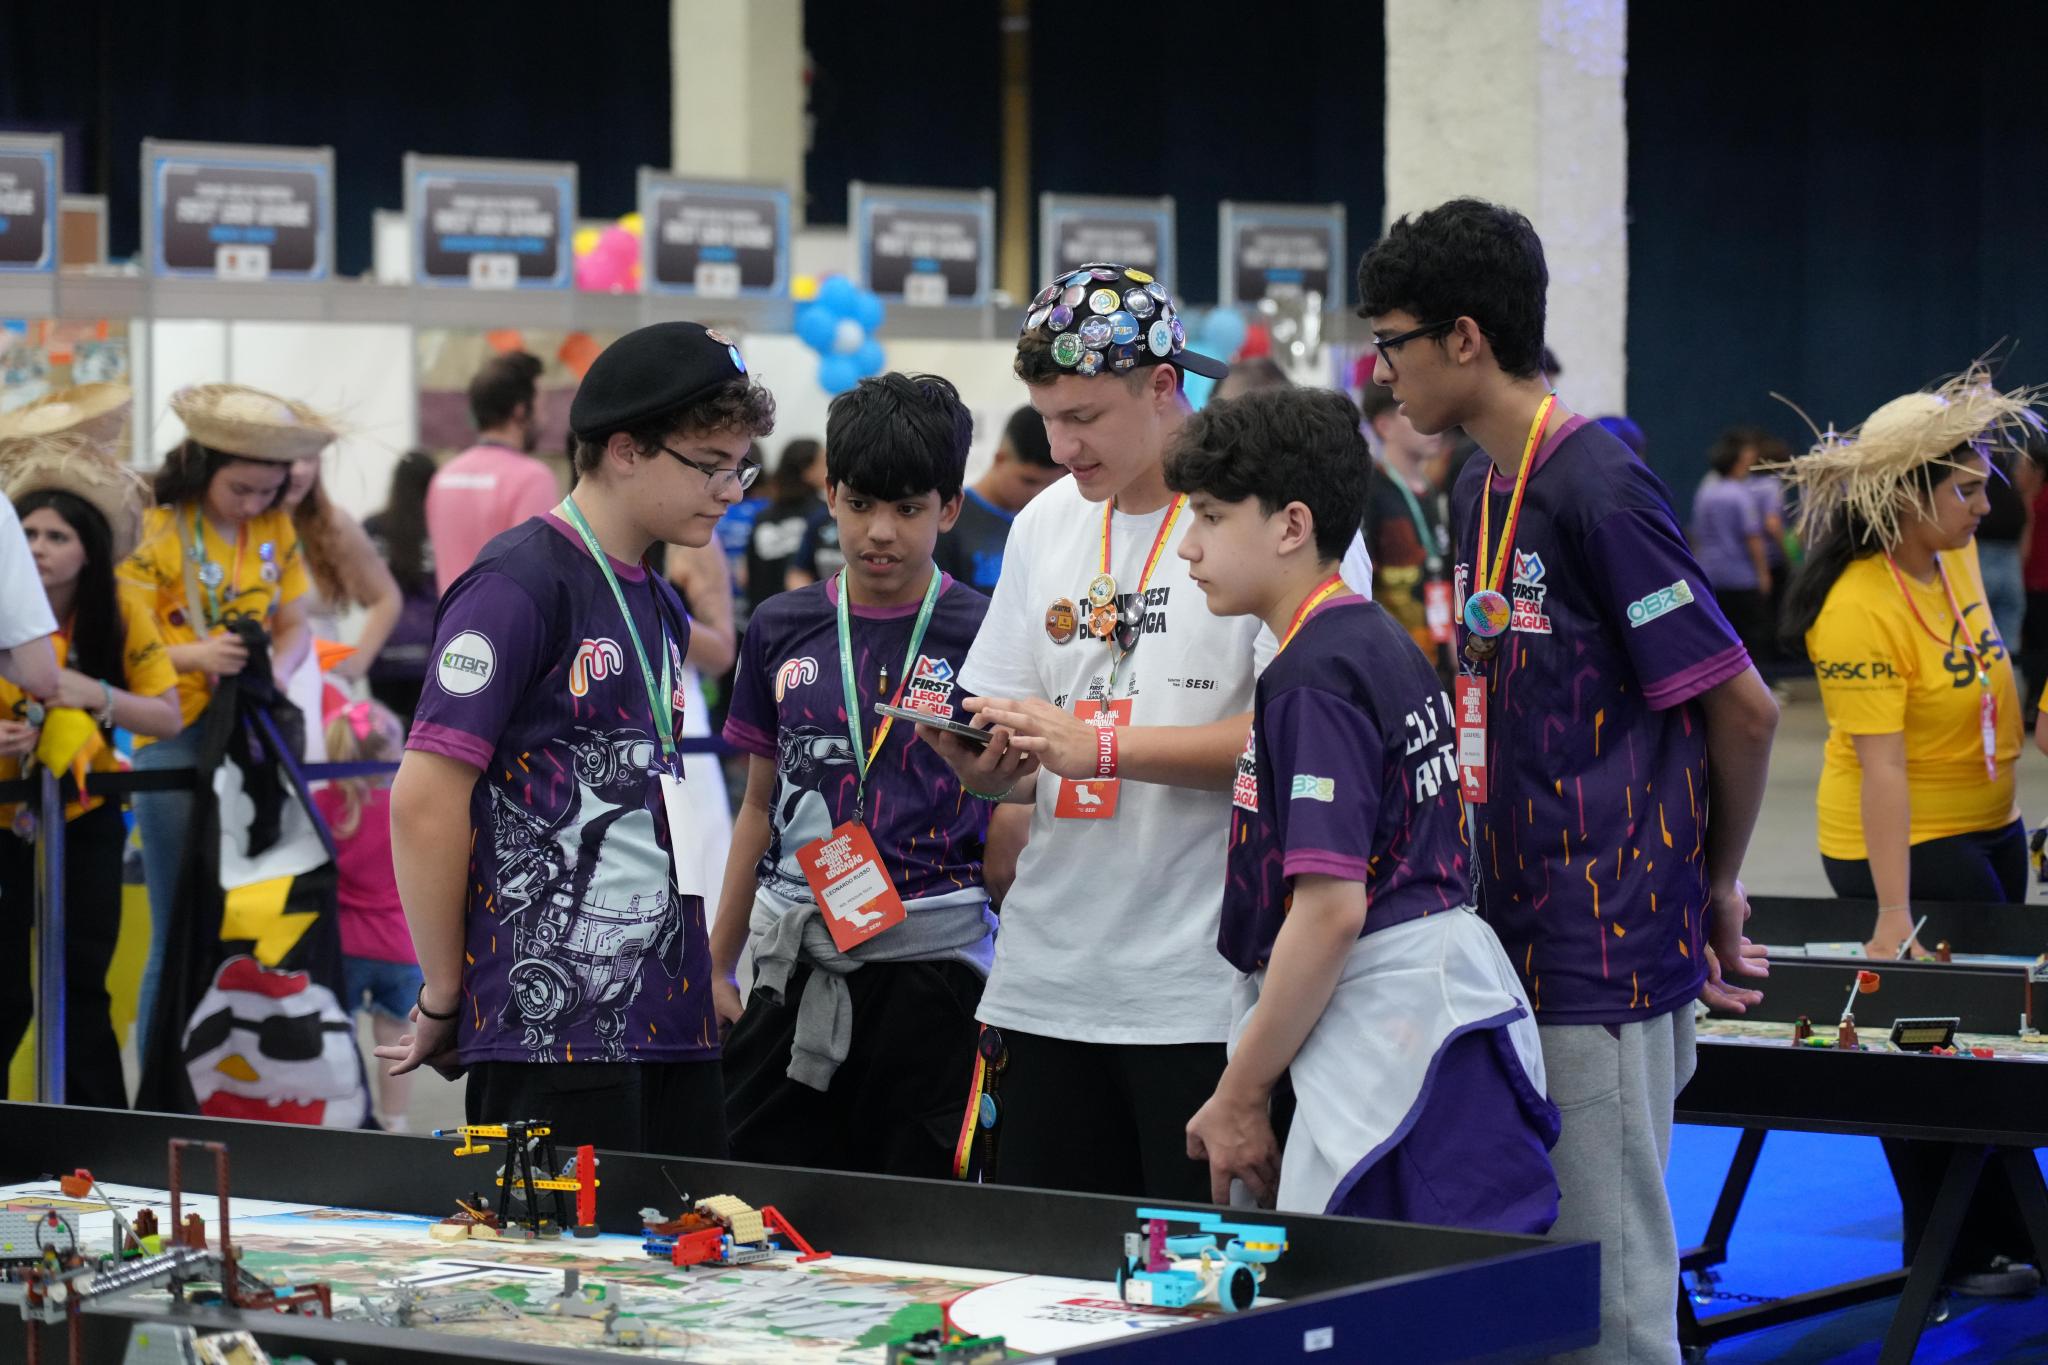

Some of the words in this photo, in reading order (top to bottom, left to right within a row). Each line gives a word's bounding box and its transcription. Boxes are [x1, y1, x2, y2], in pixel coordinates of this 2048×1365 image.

[911, 678, 951, 694] FIRST
[1185, 678, 1214, 690] SESI
[913, 689, 945, 703] LEGO
[905, 699, 951, 717] LEGUE
[1100, 731, 1114, 774] Torneio
[820, 834, 852, 857] FESTIVAL
[814, 844, 852, 868] REGIONAL
[825, 877, 854, 897] LEONARDO
[853, 867, 871, 881] RUSSO
